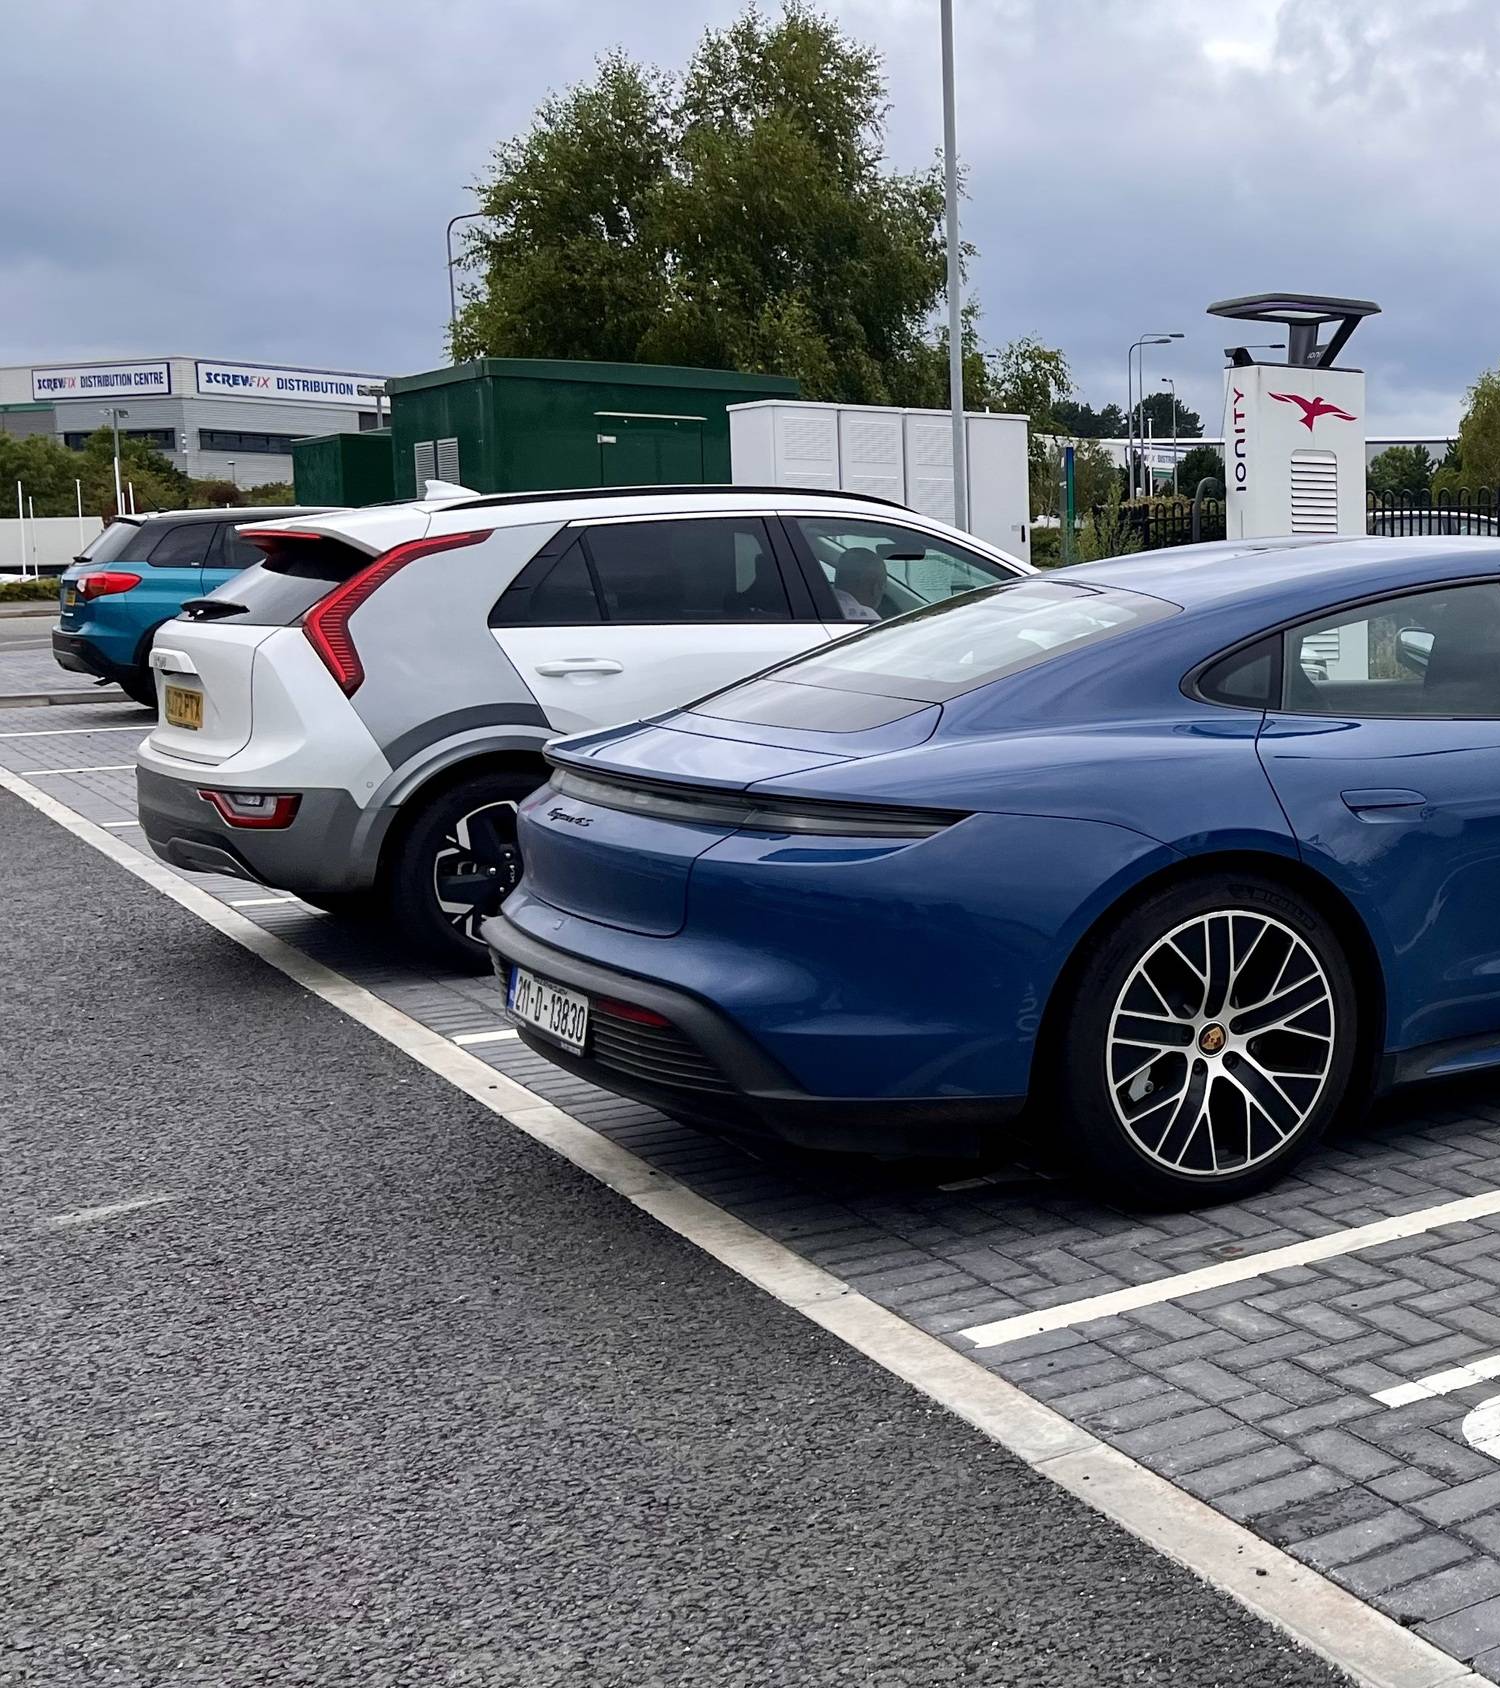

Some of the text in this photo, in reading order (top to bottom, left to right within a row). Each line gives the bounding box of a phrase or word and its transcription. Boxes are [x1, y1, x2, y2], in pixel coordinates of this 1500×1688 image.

[37, 372, 164, 391] SCREWFIX DISTRIBUTION CENTRE
[205, 372, 354, 396] SCREWFIX DISTRIBUTION
[1233, 387, 1247, 492] IONITY
[515, 976, 586, 1042] 211-D-13830
